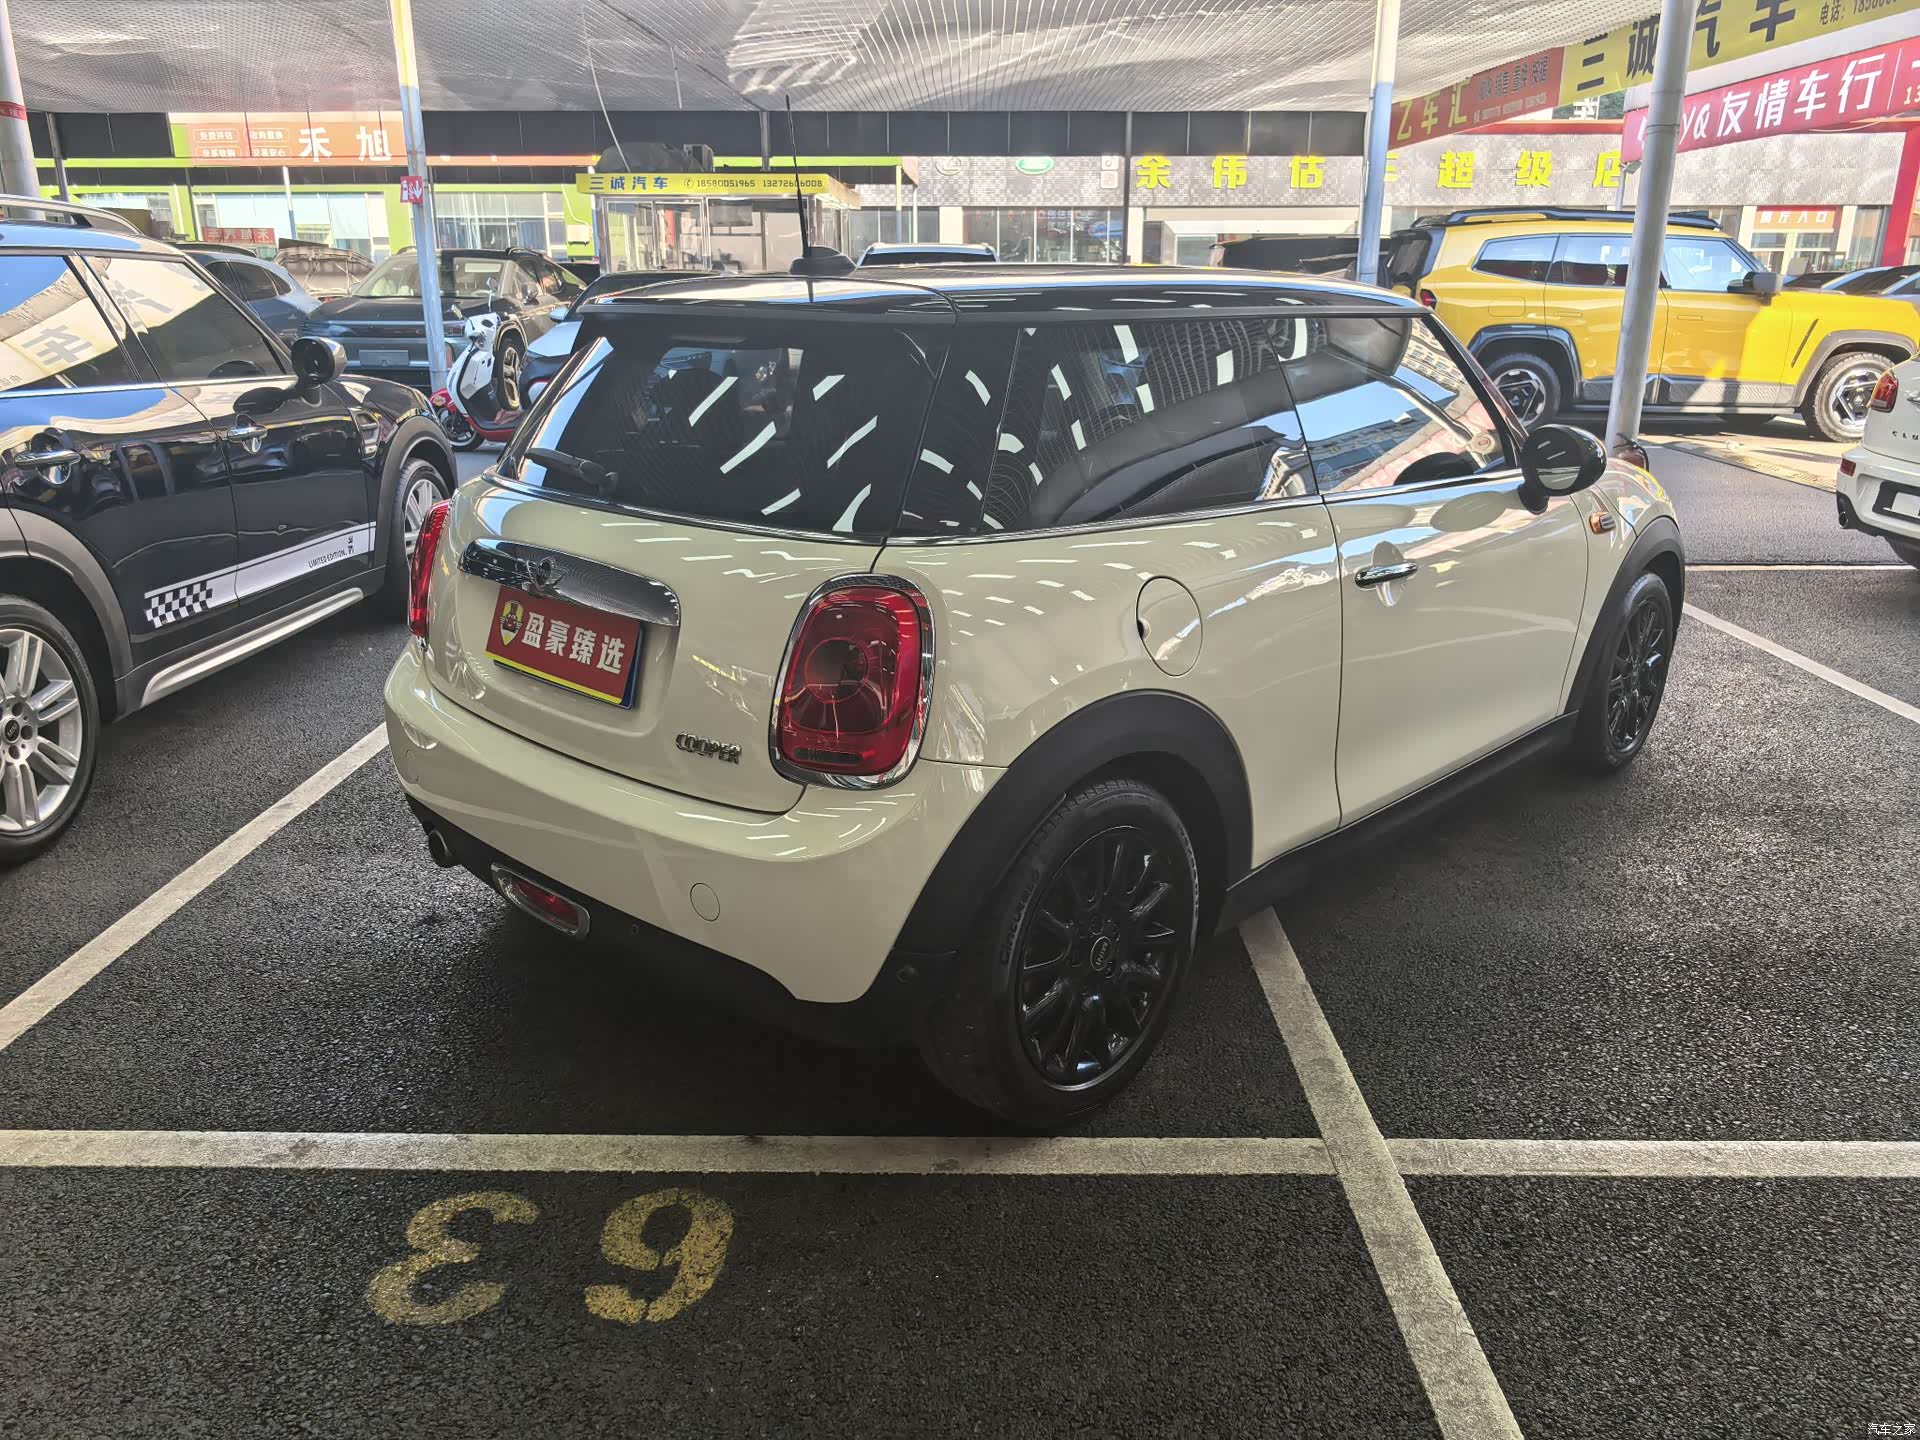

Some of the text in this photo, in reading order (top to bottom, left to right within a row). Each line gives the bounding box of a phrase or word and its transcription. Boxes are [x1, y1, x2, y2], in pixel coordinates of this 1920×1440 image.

[298, 125, 393, 162] 禾旭
[589, 176, 668, 190] 三诚汽车
[521, 611, 625, 674] 盈豪臻选
[676, 732, 742, 765] COOPER
